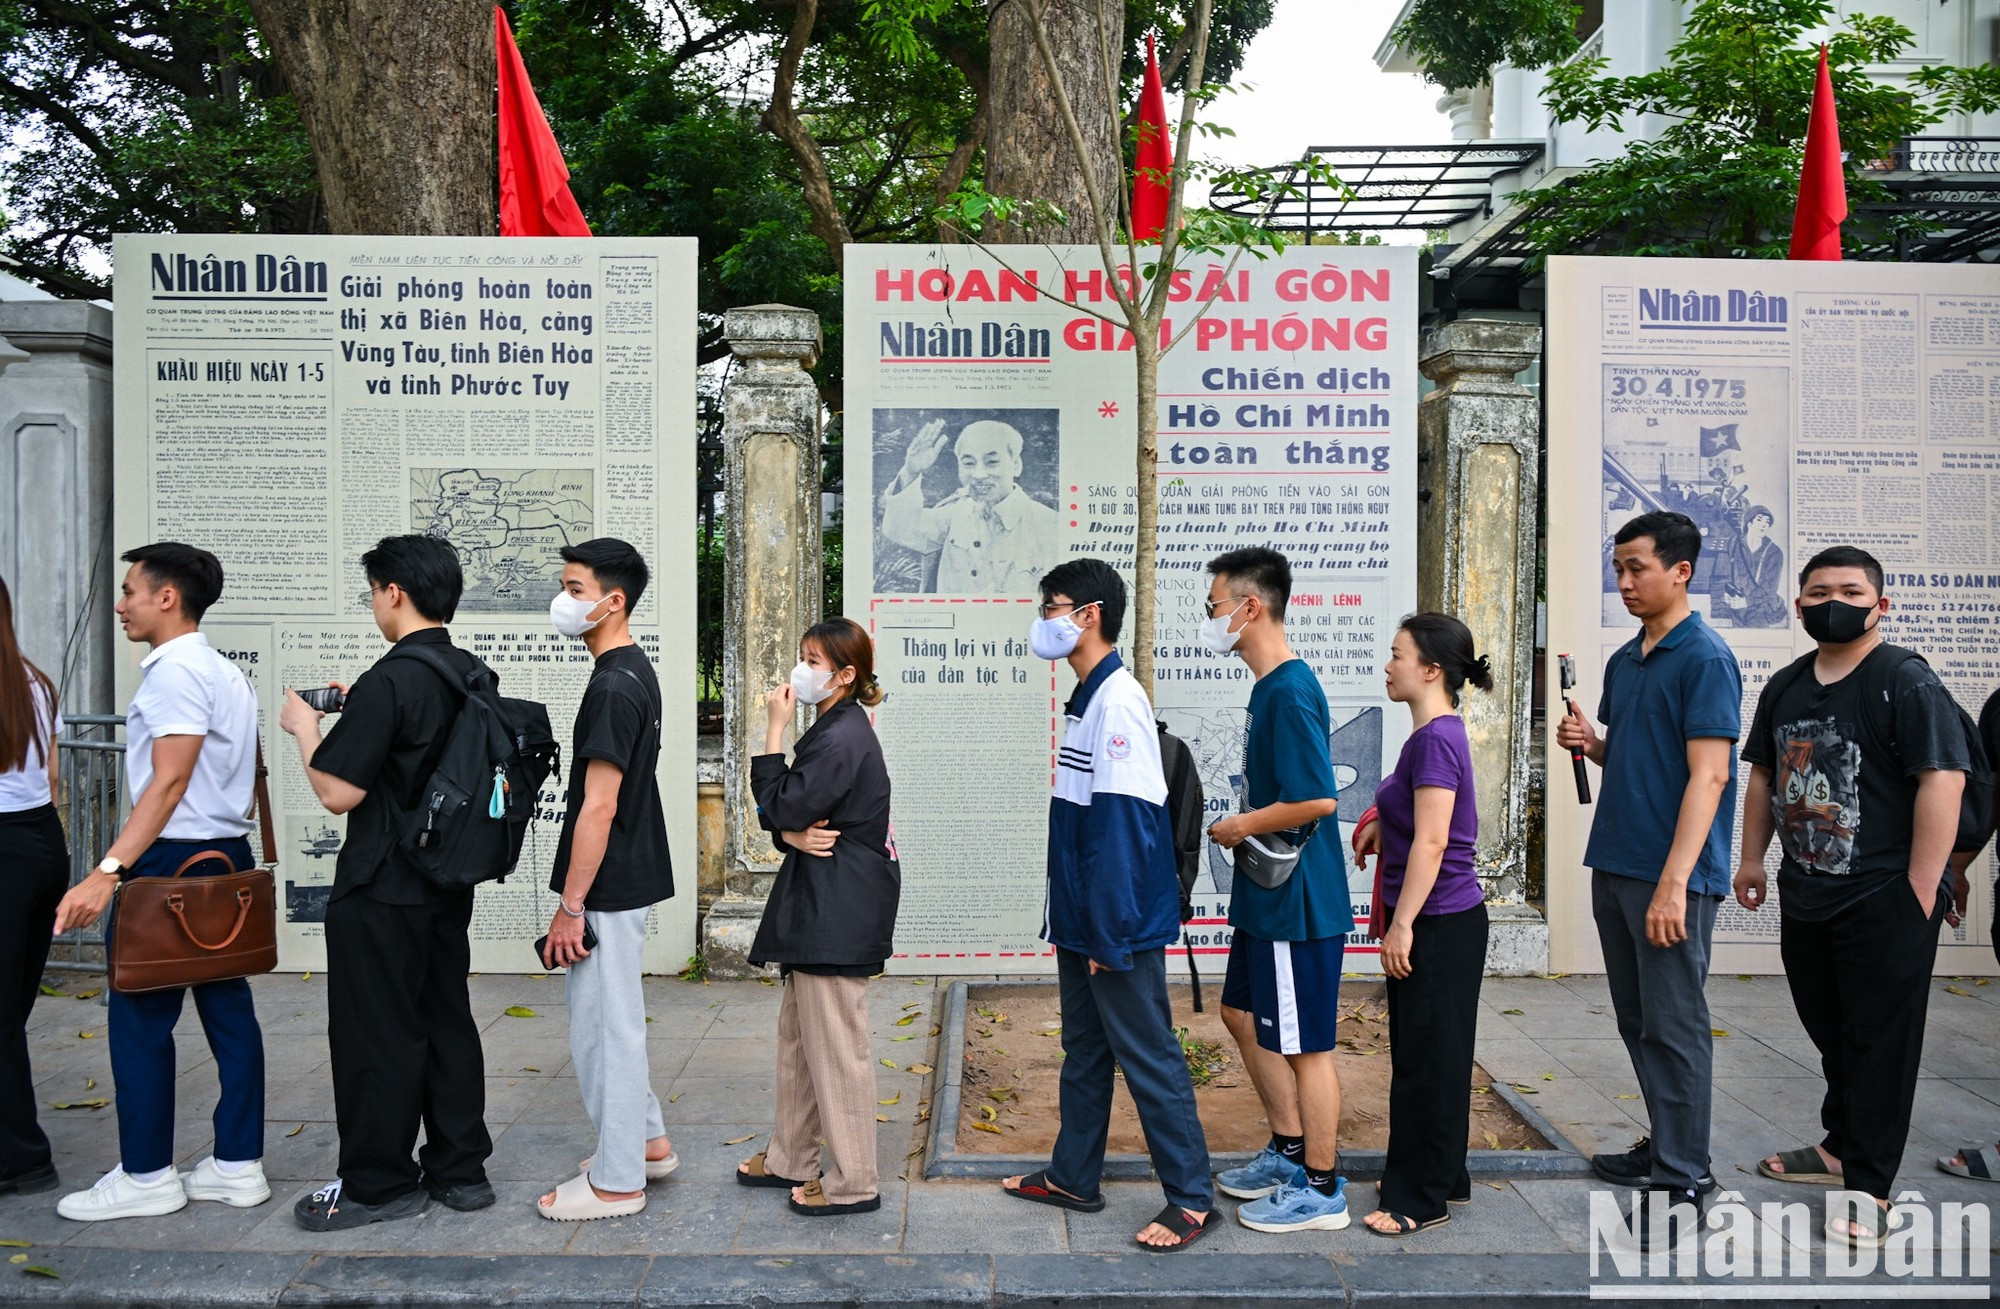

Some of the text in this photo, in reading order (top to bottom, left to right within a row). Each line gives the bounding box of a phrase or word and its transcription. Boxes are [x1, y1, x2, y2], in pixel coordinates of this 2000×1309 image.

[151, 253, 327, 292] Nhân Dân
[876, 263, 1390, 302] HOAN HÔ SÀI GÒN
[341, 276, 592, 302] Giải phóng hoàn toàn
[1639, 288, 1787, 322] Nhân Dân
[341, 308, 366, 332] thị
[380, 312, 406, 329] xã
[421, 309, 466, 329] Biên
[480, 310, 527, 334] Hòa,
[542, 312, 592, 335] cảng
[1197, 312, 1388, 350] PHÓNG
[881, 322, 1049, 357] Nhân Dân
[341, 341, 592, 367] Vũng Tàu, tỉnh Biên Hòa
[158, 358, 323, 384] KHẨU HIỆU NGÀY 1-5
[1202, 367, 1390, 393] Chiến dịch
[366, 374, 569, 400] và tỉnh Phước Tuy
[1612, 376, 1746, 399] 30.4.1975
[1169, 403, 1389, 427] Hồ Chí Minh
[1170, 440, 1390, 471] toàn thắng
[1088, 484, 1116, 497] SÁNG
[1202, 484, 1223, 497] GIẢI
[1232, 484, 1268, 497] PHÓNG
[1279, 483, 1300, 497] TIẾN
[1308, 485, 1330, 497] VÀO
[1341, 484, 1357, 497] SÀI
[1367, 485, 1390, 497] GÒN
[1089, 522, 1389, 535] Đồng thành phố Hồ Chí Minh
[1899, 573, 1984, 588] TRA SỐ DÂN
[1291, 594, 1361, 607] MỆNH LỆNH
[1300, 614, 1374, 626] BỘ CHỈ HUY CÁC
[1956, 615, 1989, 624] chiếm
[1299, 631, 1374, 642] LƯỢNG VŨ TRANG
[903, 638, 1027, 660] Thắng lợi vĩ đại
[1304, 647, 1374, 658] DÂN GIẢI PHÓNG
[902, 665, 1026, 686] của dân tộc ta
[1331, 664, 1373, 675] VIỆT NAM
